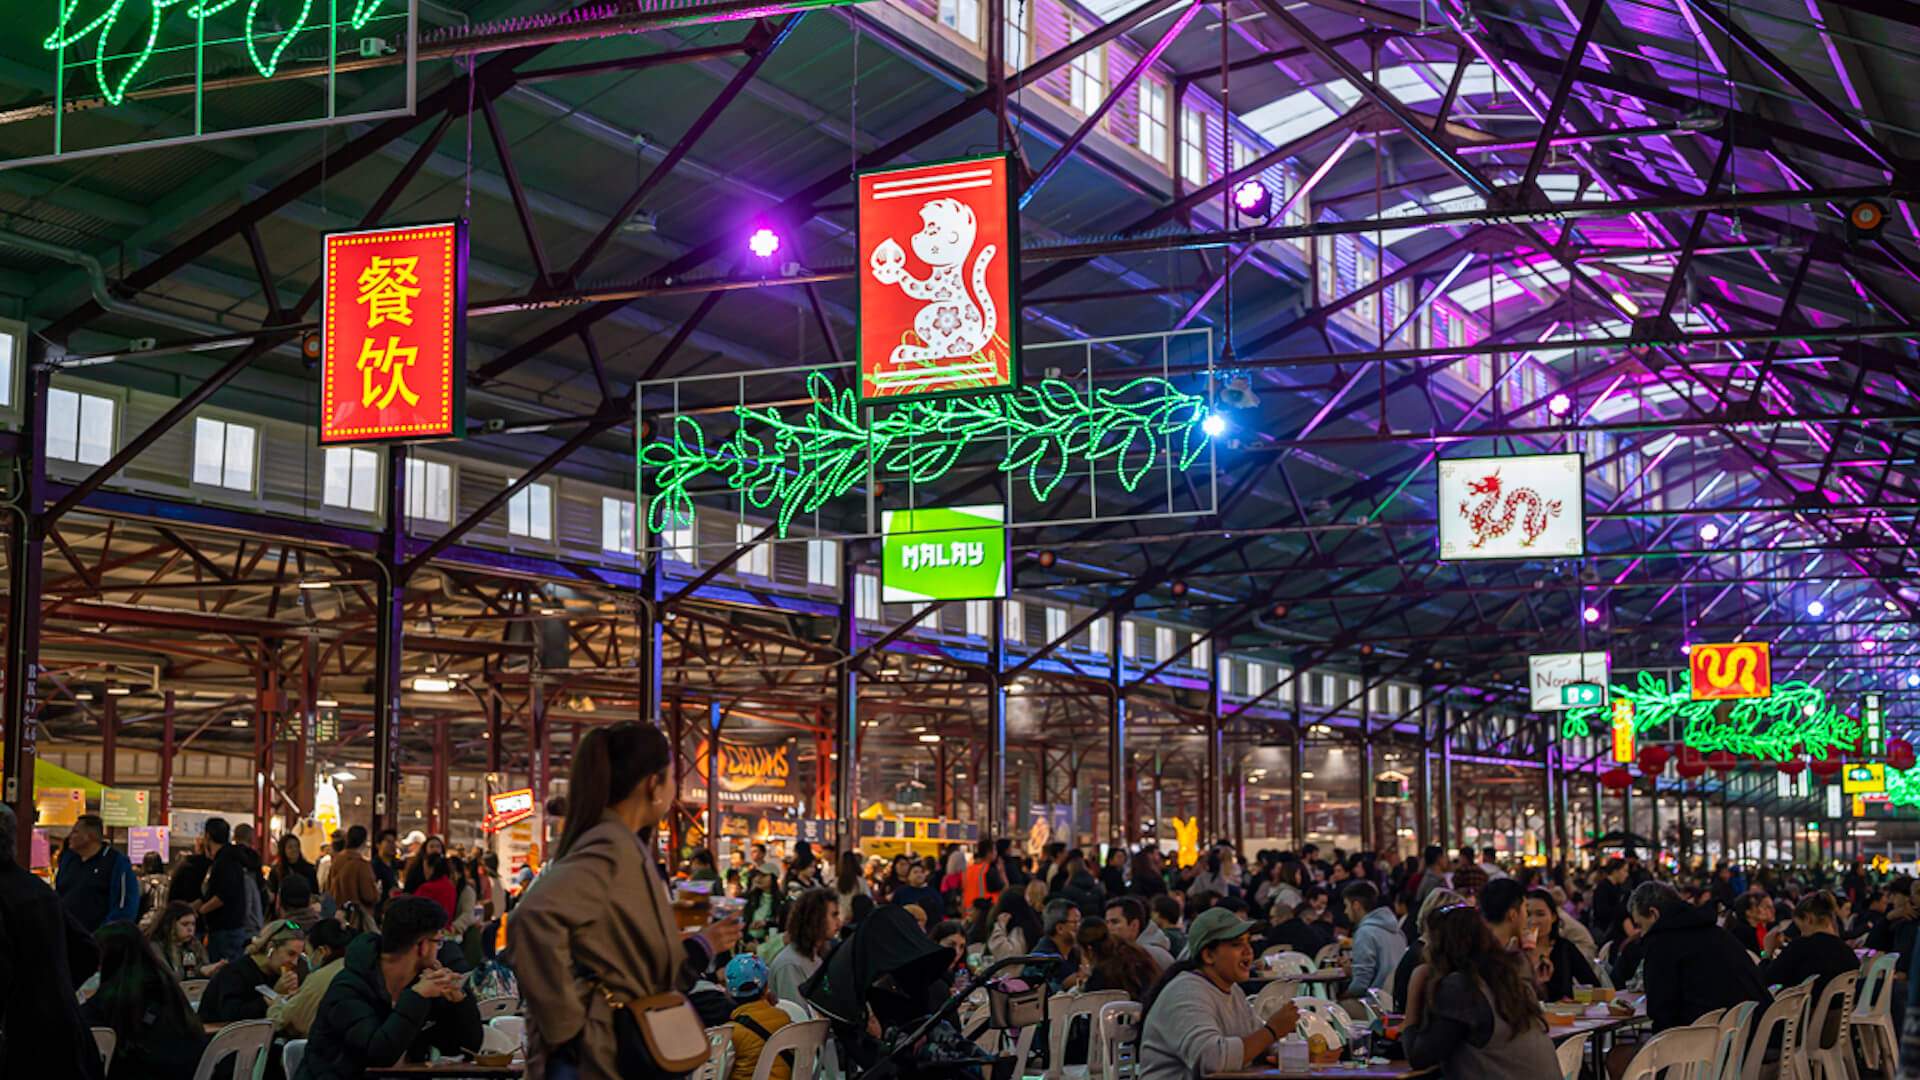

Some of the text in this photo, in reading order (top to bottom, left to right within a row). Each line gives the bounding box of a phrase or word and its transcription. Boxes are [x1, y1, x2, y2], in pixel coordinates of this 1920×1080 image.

[356, 255, 421, 410] 餐饮
[902, 541, 985, 572] MALAY
[725, 745, 790, 777] DRUMS
